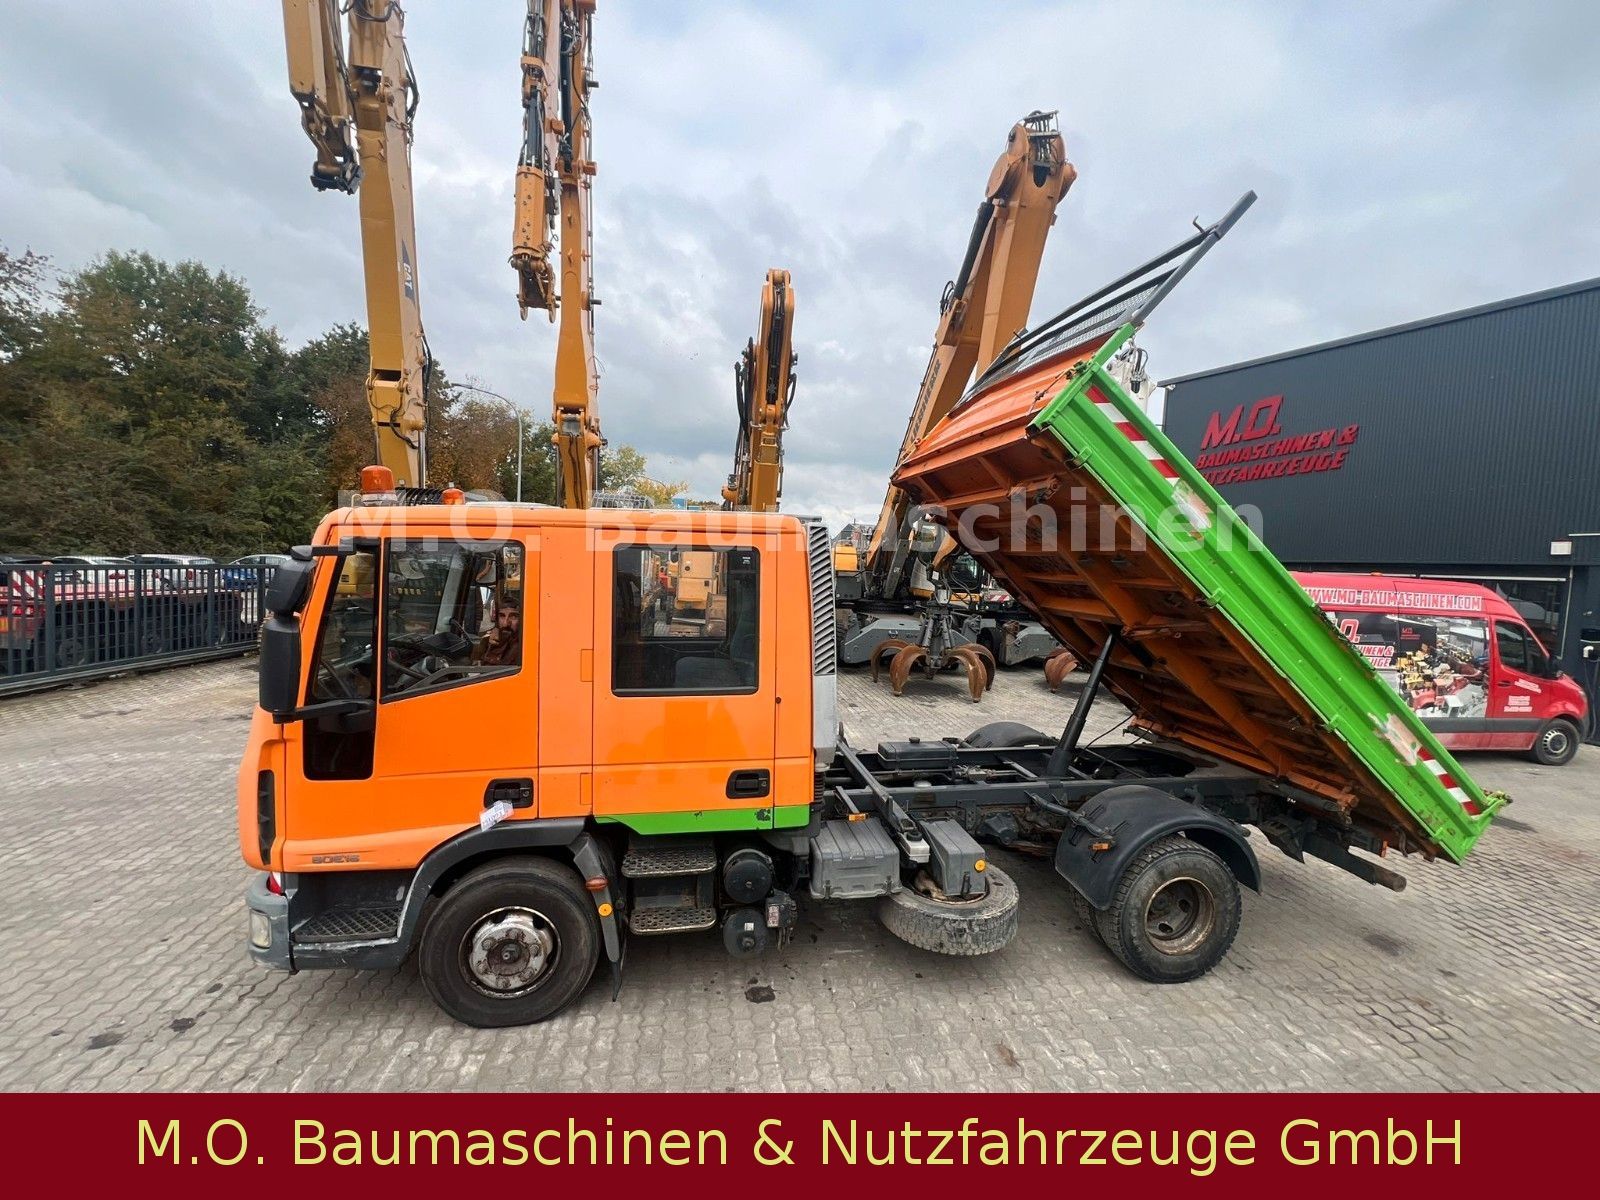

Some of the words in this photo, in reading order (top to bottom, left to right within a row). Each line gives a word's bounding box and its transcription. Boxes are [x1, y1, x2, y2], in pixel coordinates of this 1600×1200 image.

[1201, 394, 1284, 450] M.O.
[1196, 428, 1337, 469] BAUMASCHINEN
[1336, 423, 1360, 446] &
[1305, 587, 1483, 611] WW.MO-BAUMASCHINEN.COM
